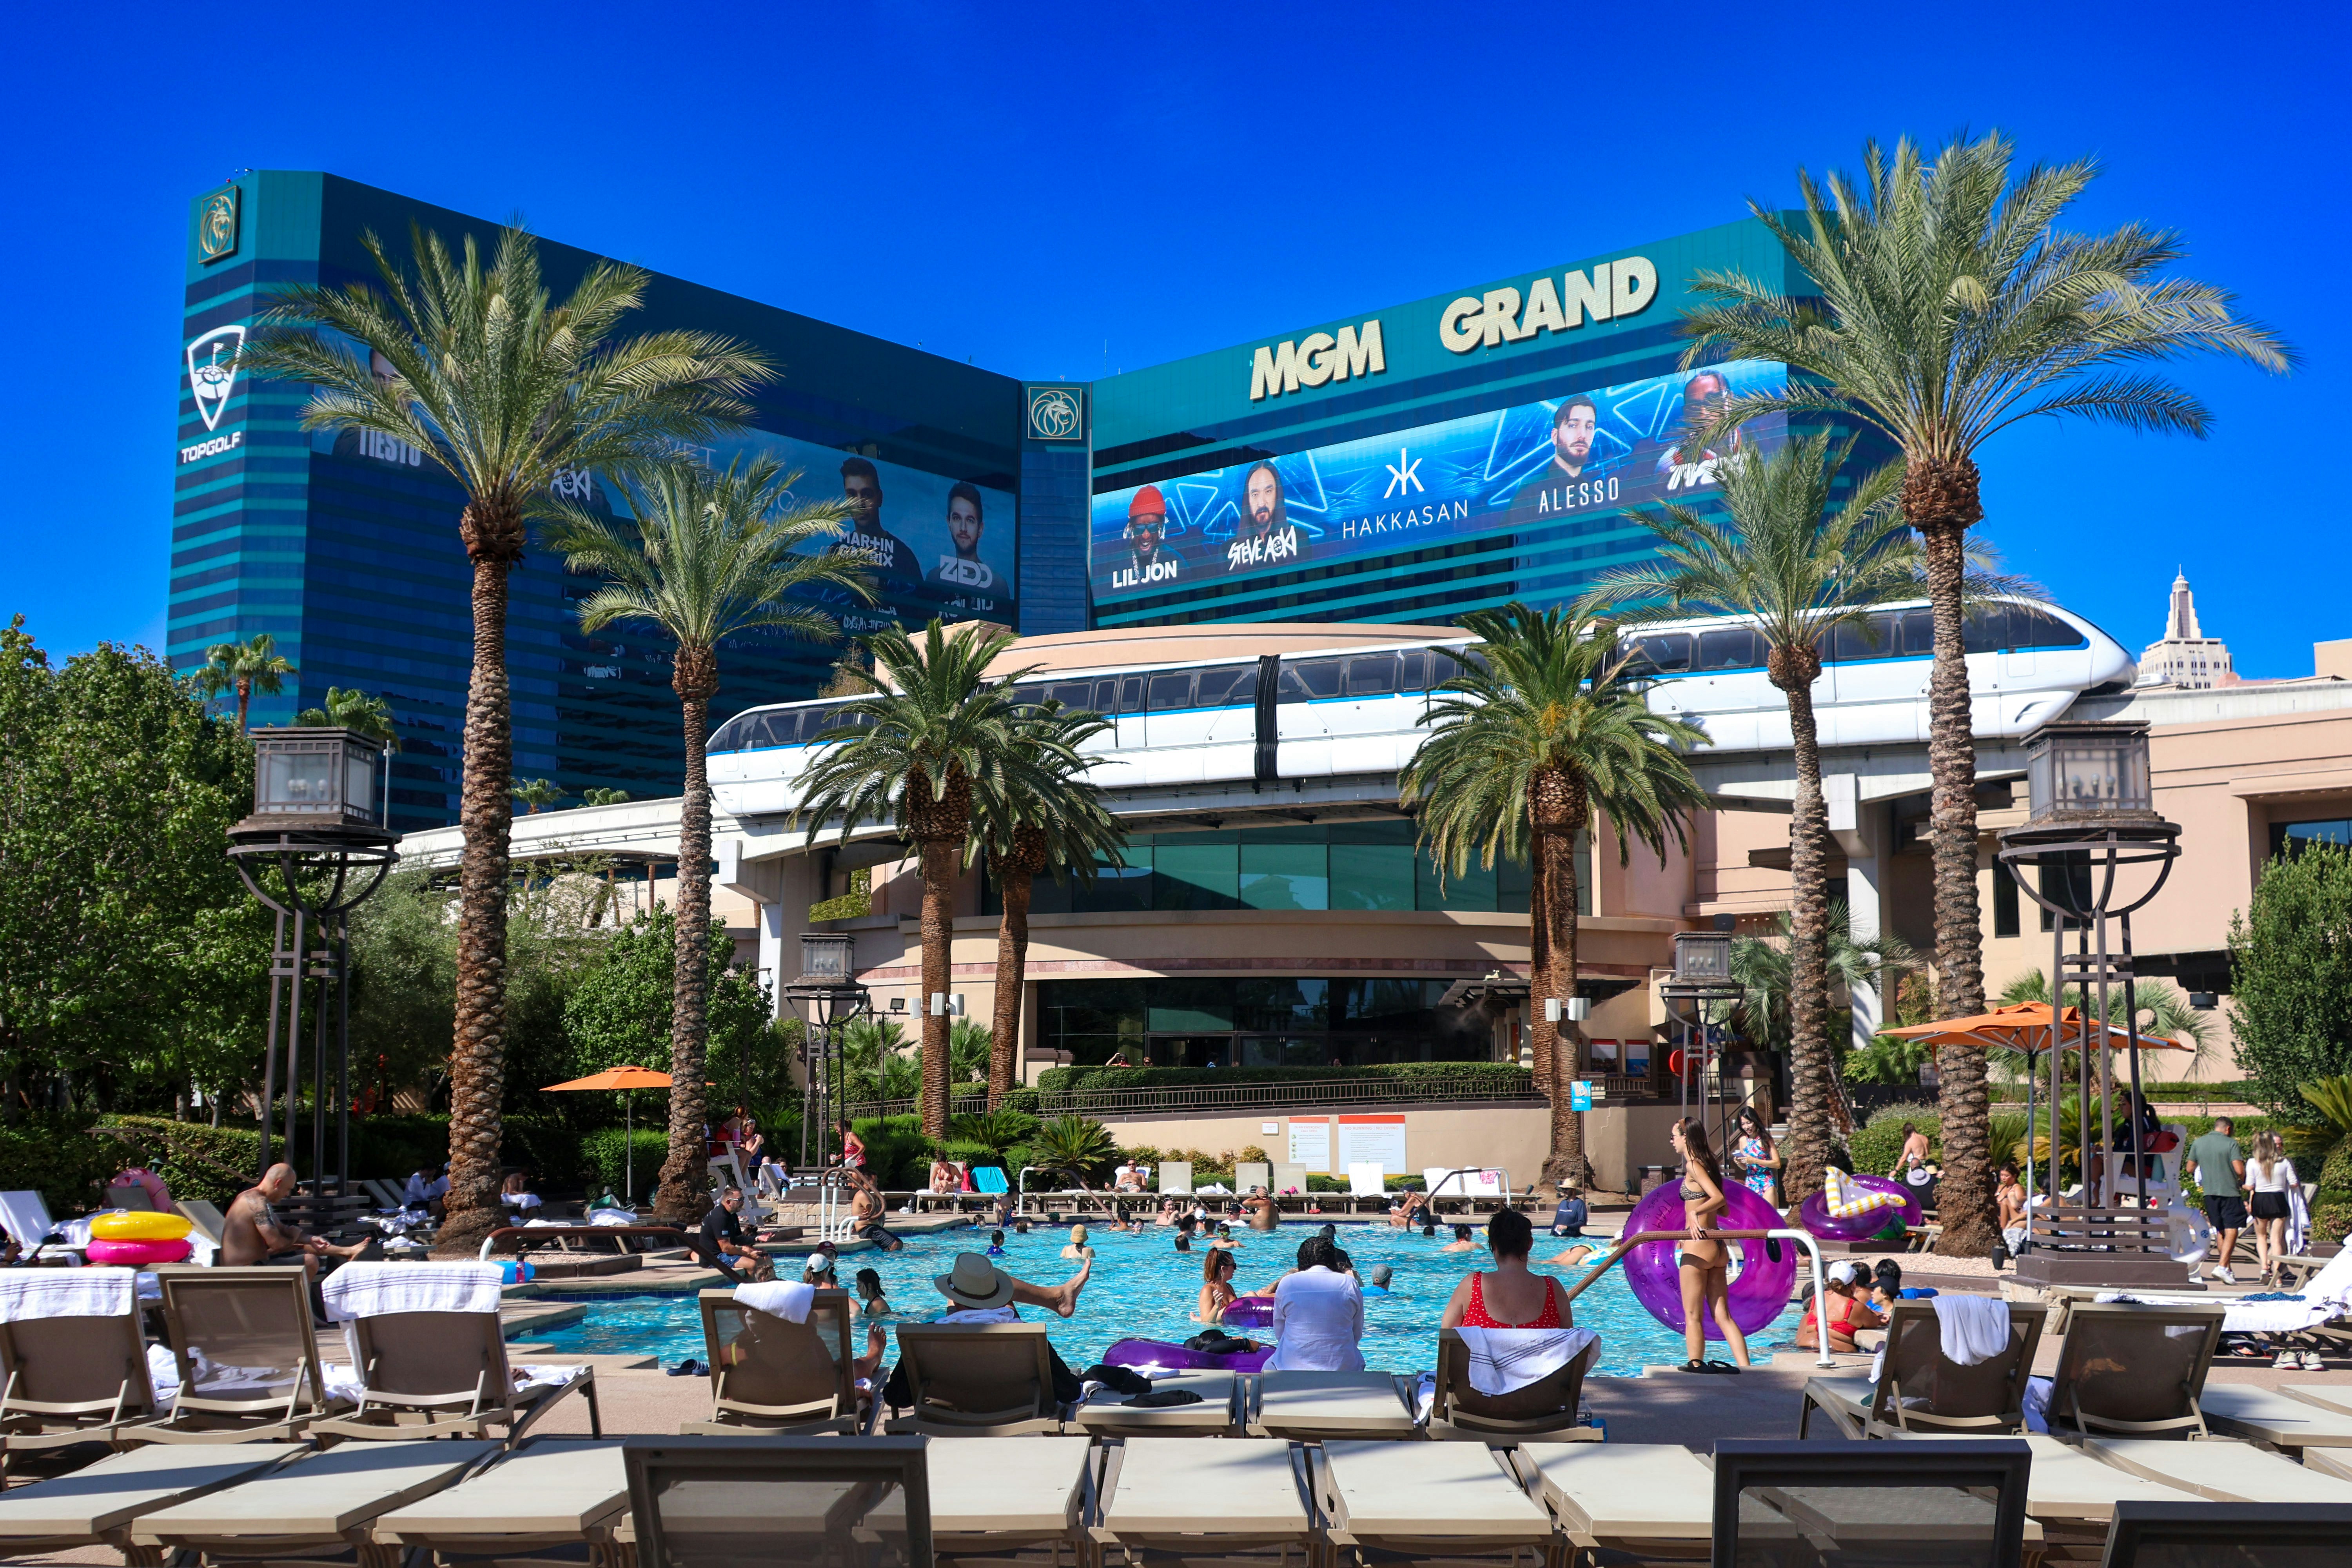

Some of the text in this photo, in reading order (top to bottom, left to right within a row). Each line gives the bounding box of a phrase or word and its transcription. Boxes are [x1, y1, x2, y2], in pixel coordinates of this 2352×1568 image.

[1250, 256, 1657, 401] MGM GRAND
[181, 431, 241, 463] TOPGOLF
[1539, 477, 1618, 513] ALESSO
[1343, 499, 1467, 539] HAKKASAN
[839, 530, 894, 553] MARTIN
[1227, 525, 1297, 571] STEVE AOKI
[940, 554, 993, 588] ZEDD
[1113, 560, 1177, 588] LIL JON
[1652, 1200, 1674, 1228] TEAM
